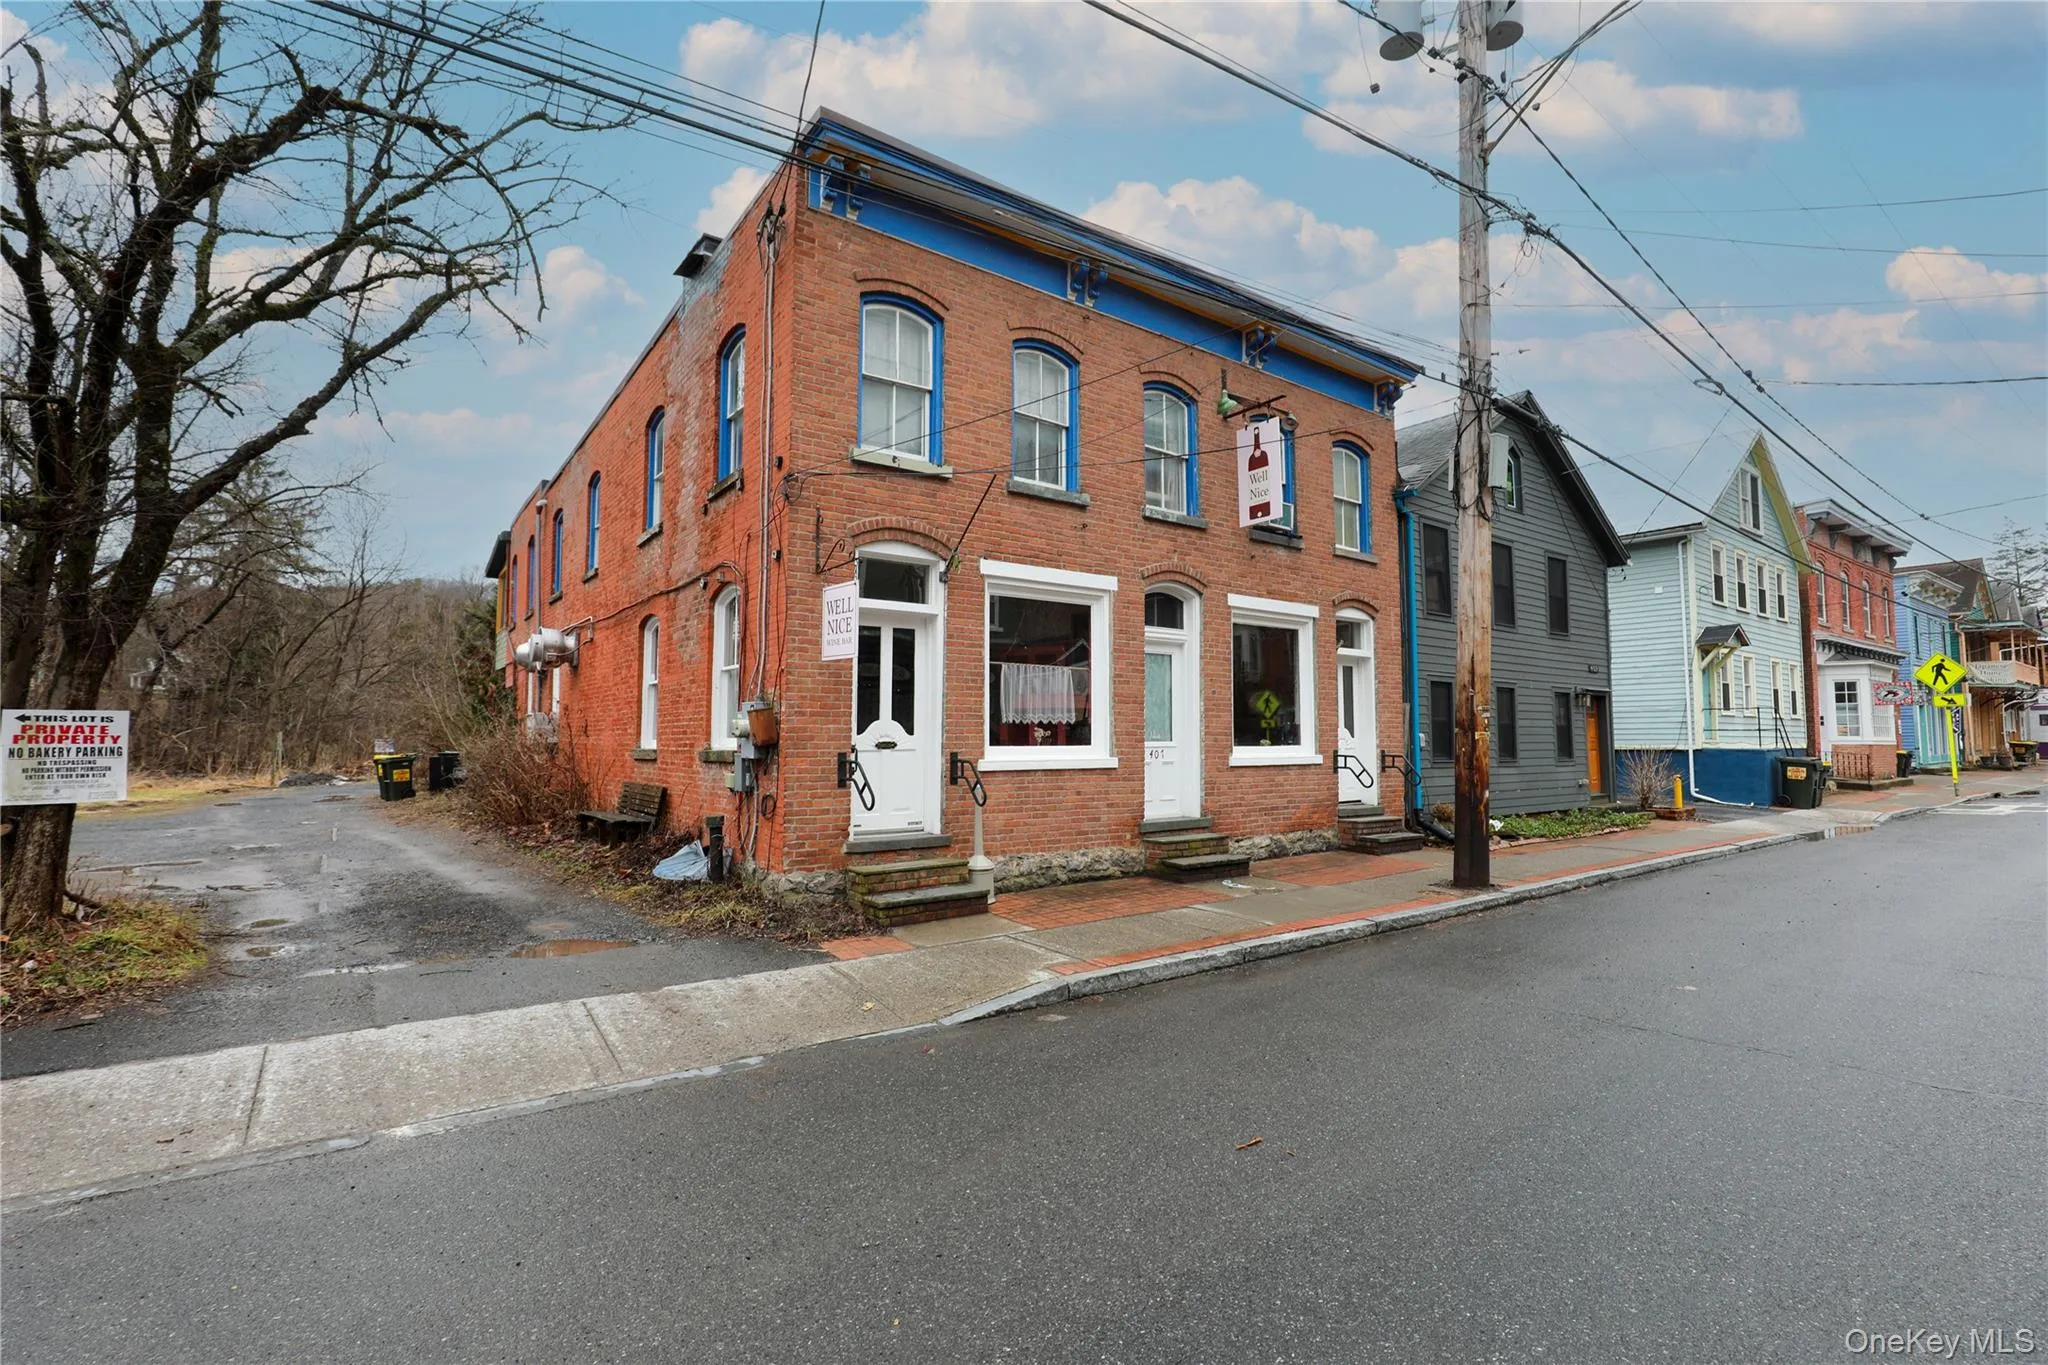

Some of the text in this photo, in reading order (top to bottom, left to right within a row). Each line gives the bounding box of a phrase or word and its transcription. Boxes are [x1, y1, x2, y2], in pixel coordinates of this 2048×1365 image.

[1249, 469, 1268, 484] Well
[1250, 488, 1269, 500] Nice
[826, 597, 853, 616] WELL
[827, 616, 852, 636] NICE
[100, 715, 115, 723] IS
[20, 724, 110, 735] PRIVATE
[12, 734, 121, 744] PROPERTY
[8, 746, 123, 758] NO BAKERY PARKING
